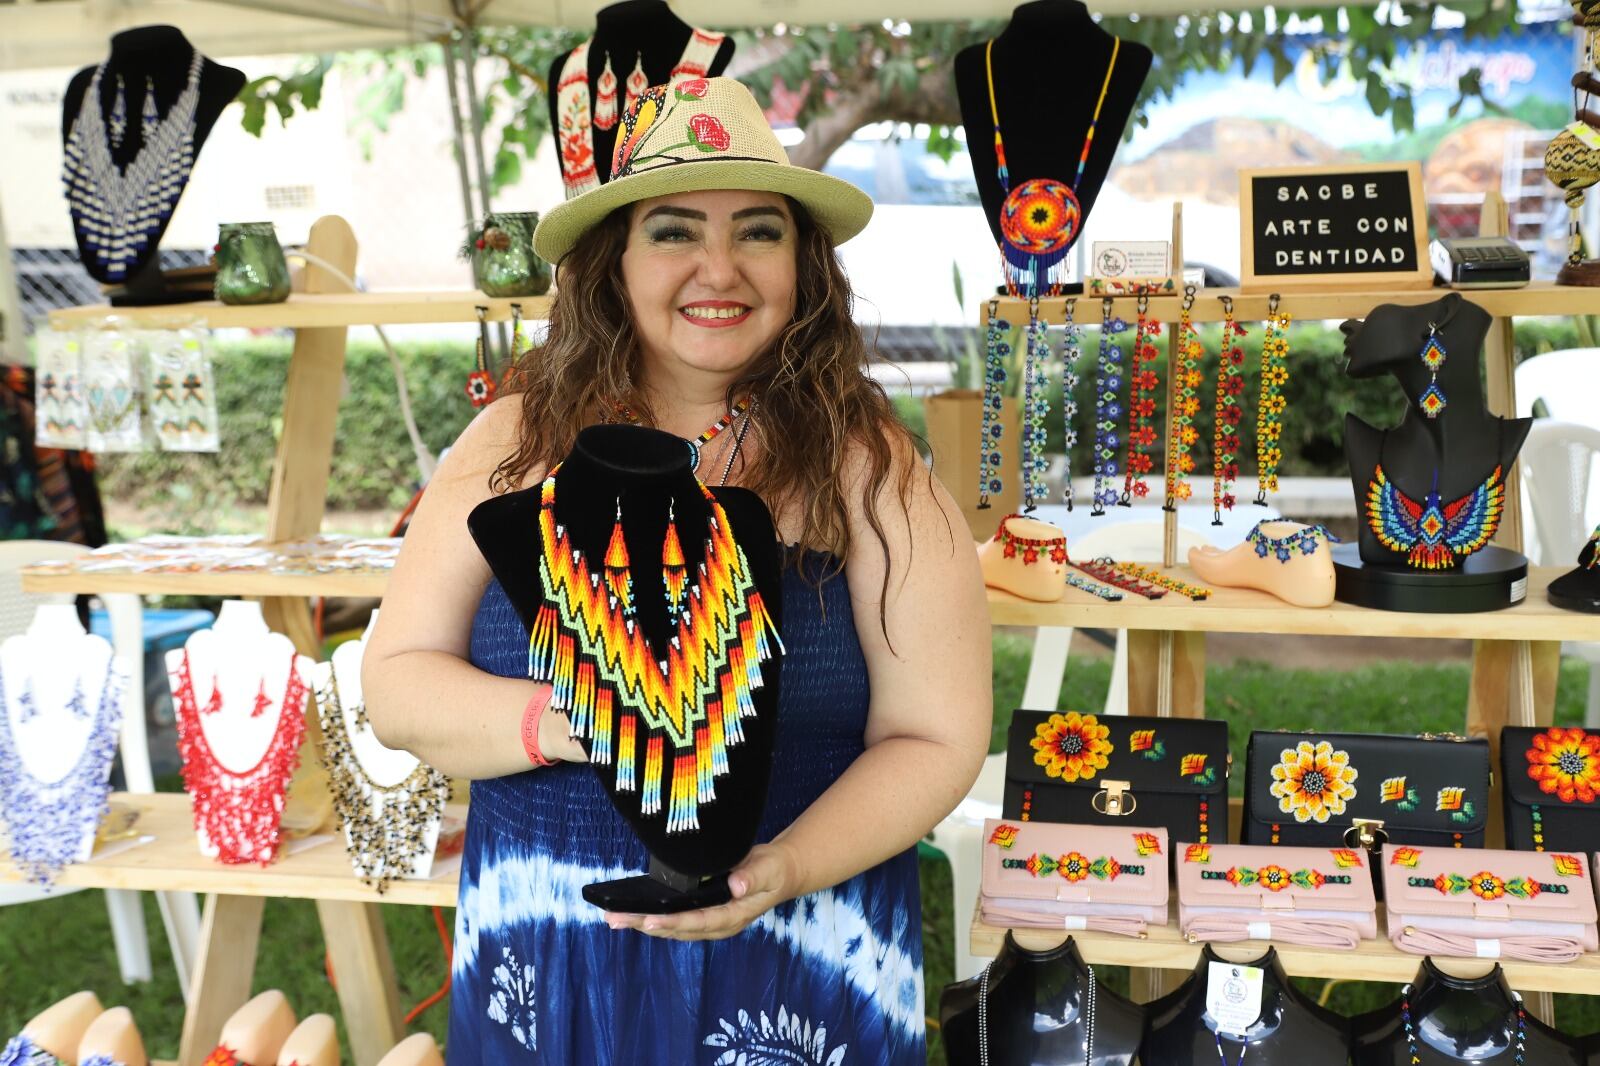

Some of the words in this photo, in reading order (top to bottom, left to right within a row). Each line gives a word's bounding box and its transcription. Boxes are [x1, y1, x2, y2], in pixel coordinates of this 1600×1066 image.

[1277, 183, 1378, 202] SACBE
[1264, 219, 1331, 236] ARTE
[1356, 217, 1408, 233] CON
[1275, 247, 1405, 266] DENTIDAD
